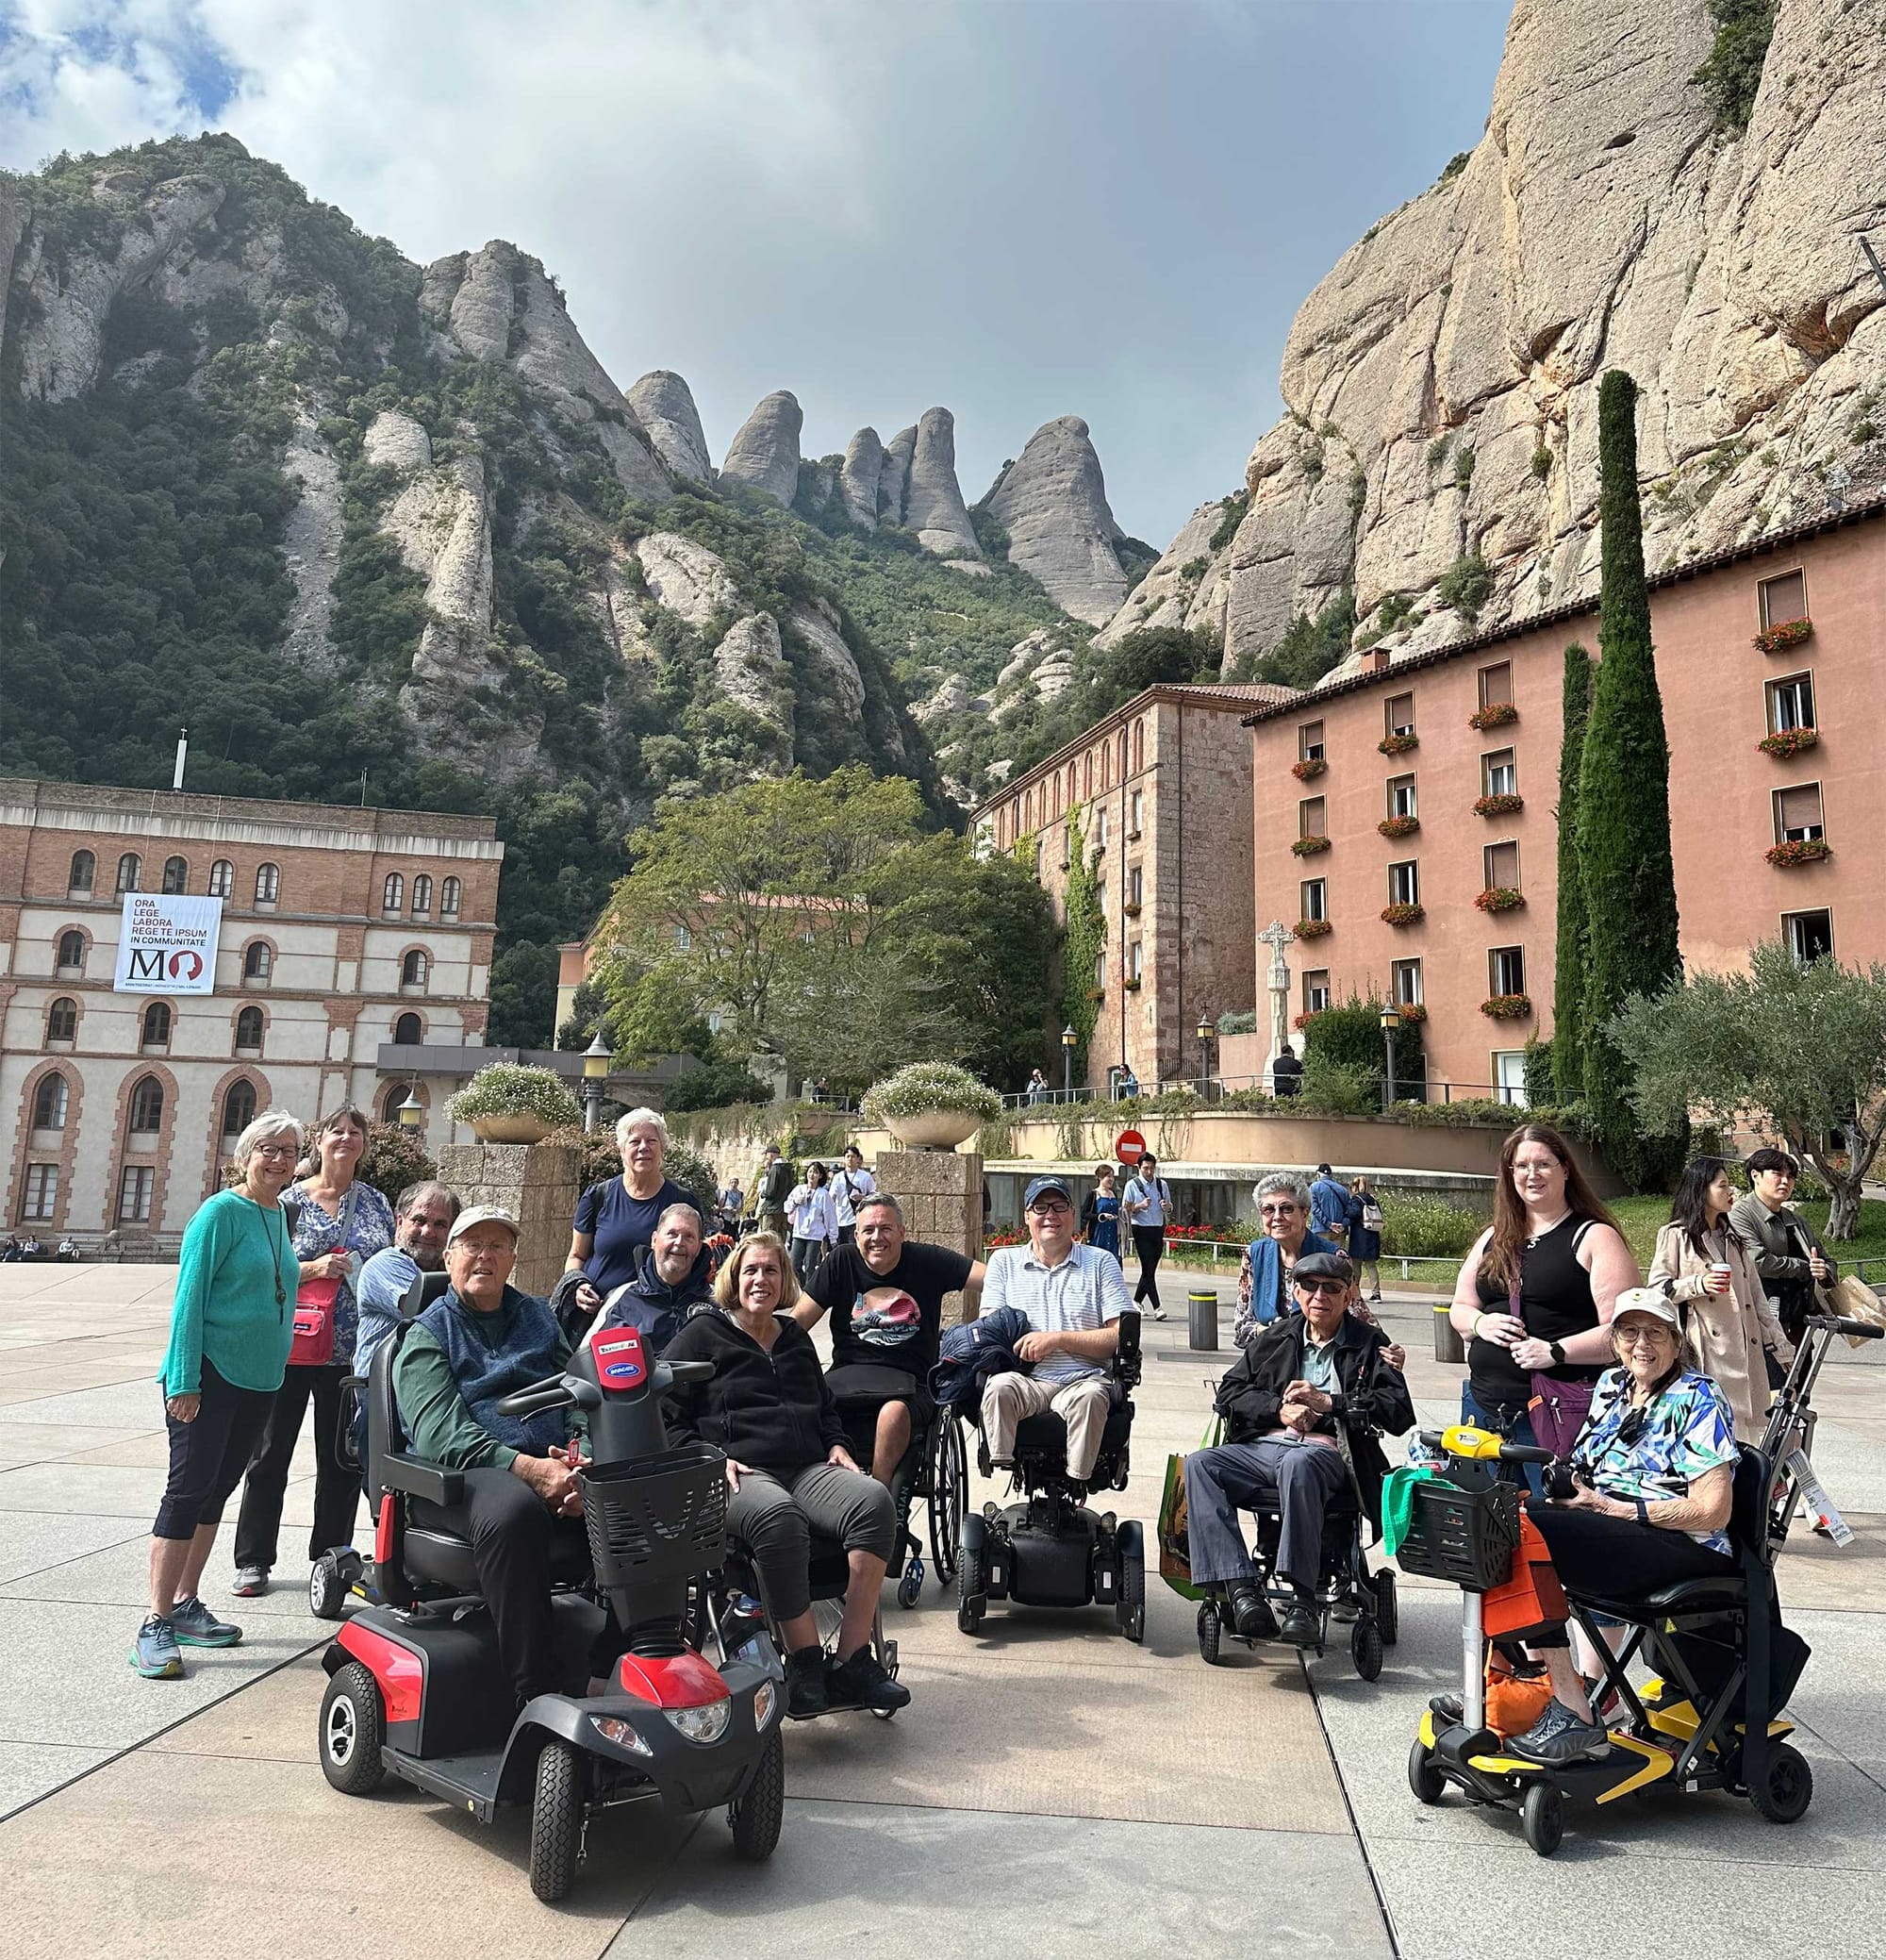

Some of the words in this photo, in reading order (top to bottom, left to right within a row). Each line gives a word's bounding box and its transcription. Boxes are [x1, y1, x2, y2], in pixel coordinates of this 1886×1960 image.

[135, 899, 155, 907] ORA
[134, 908, 159, 917] LEGE
[133, 918, 173, 926] LABORA
[141, 937, 207, 946] COMMUNITATE
